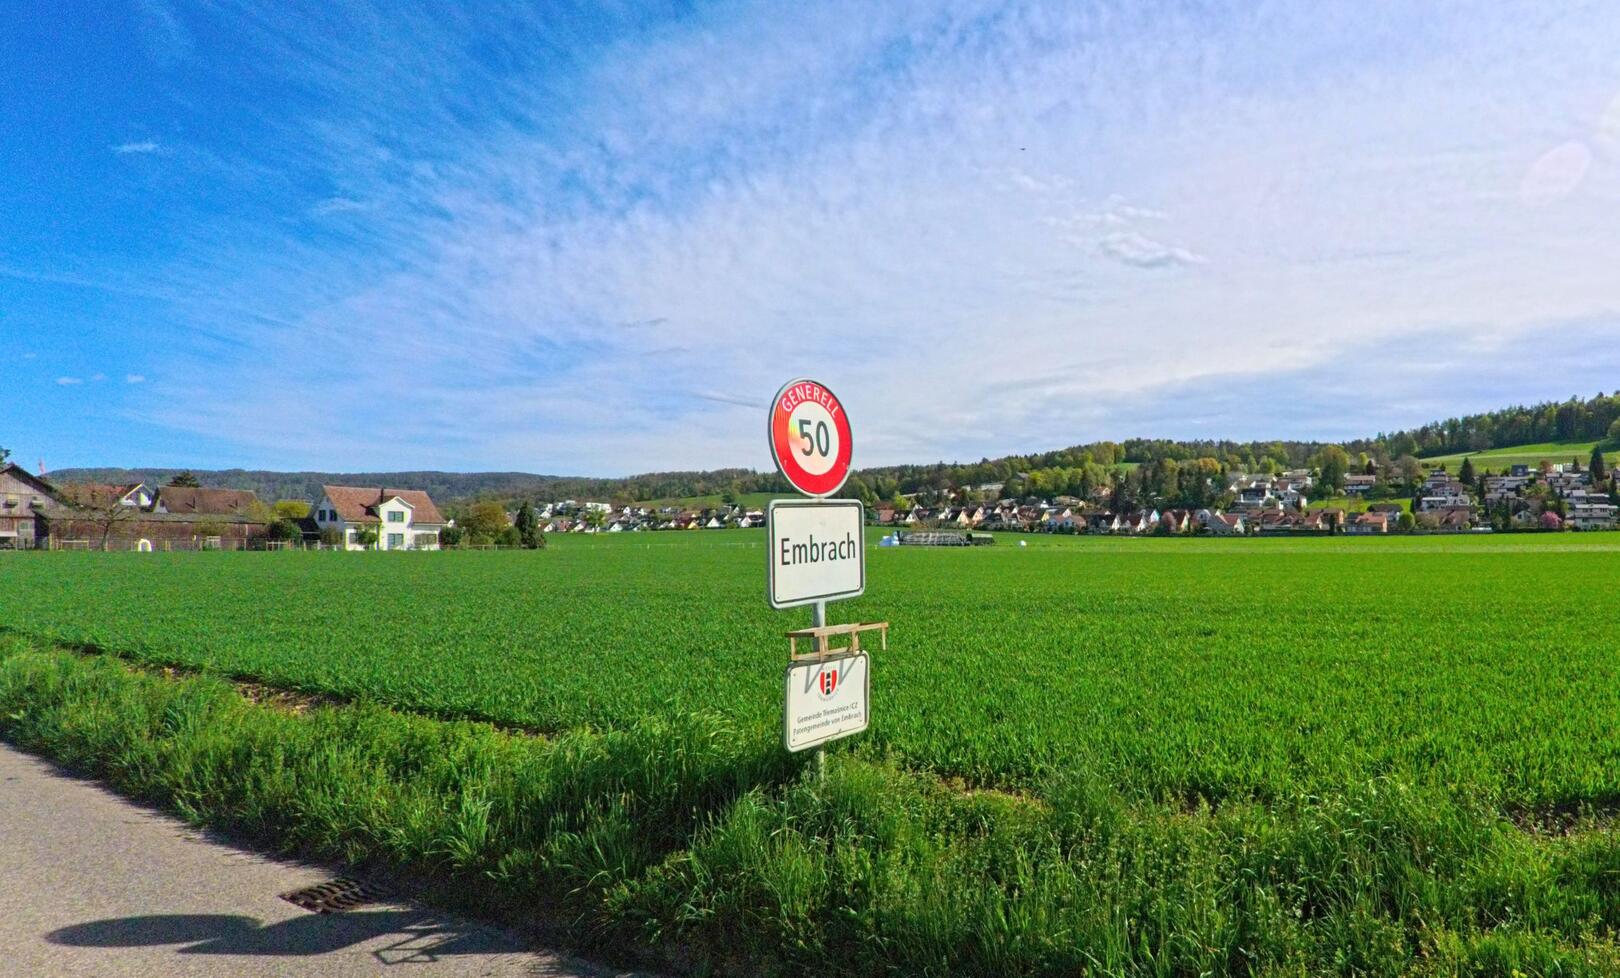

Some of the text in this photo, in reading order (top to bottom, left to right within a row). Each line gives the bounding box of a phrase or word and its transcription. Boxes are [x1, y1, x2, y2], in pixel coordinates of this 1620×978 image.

[781, 384, 839, 418] GENERELL
[798, 419, 830, 457] 50
[781, 531, 856, 566] Embrach
